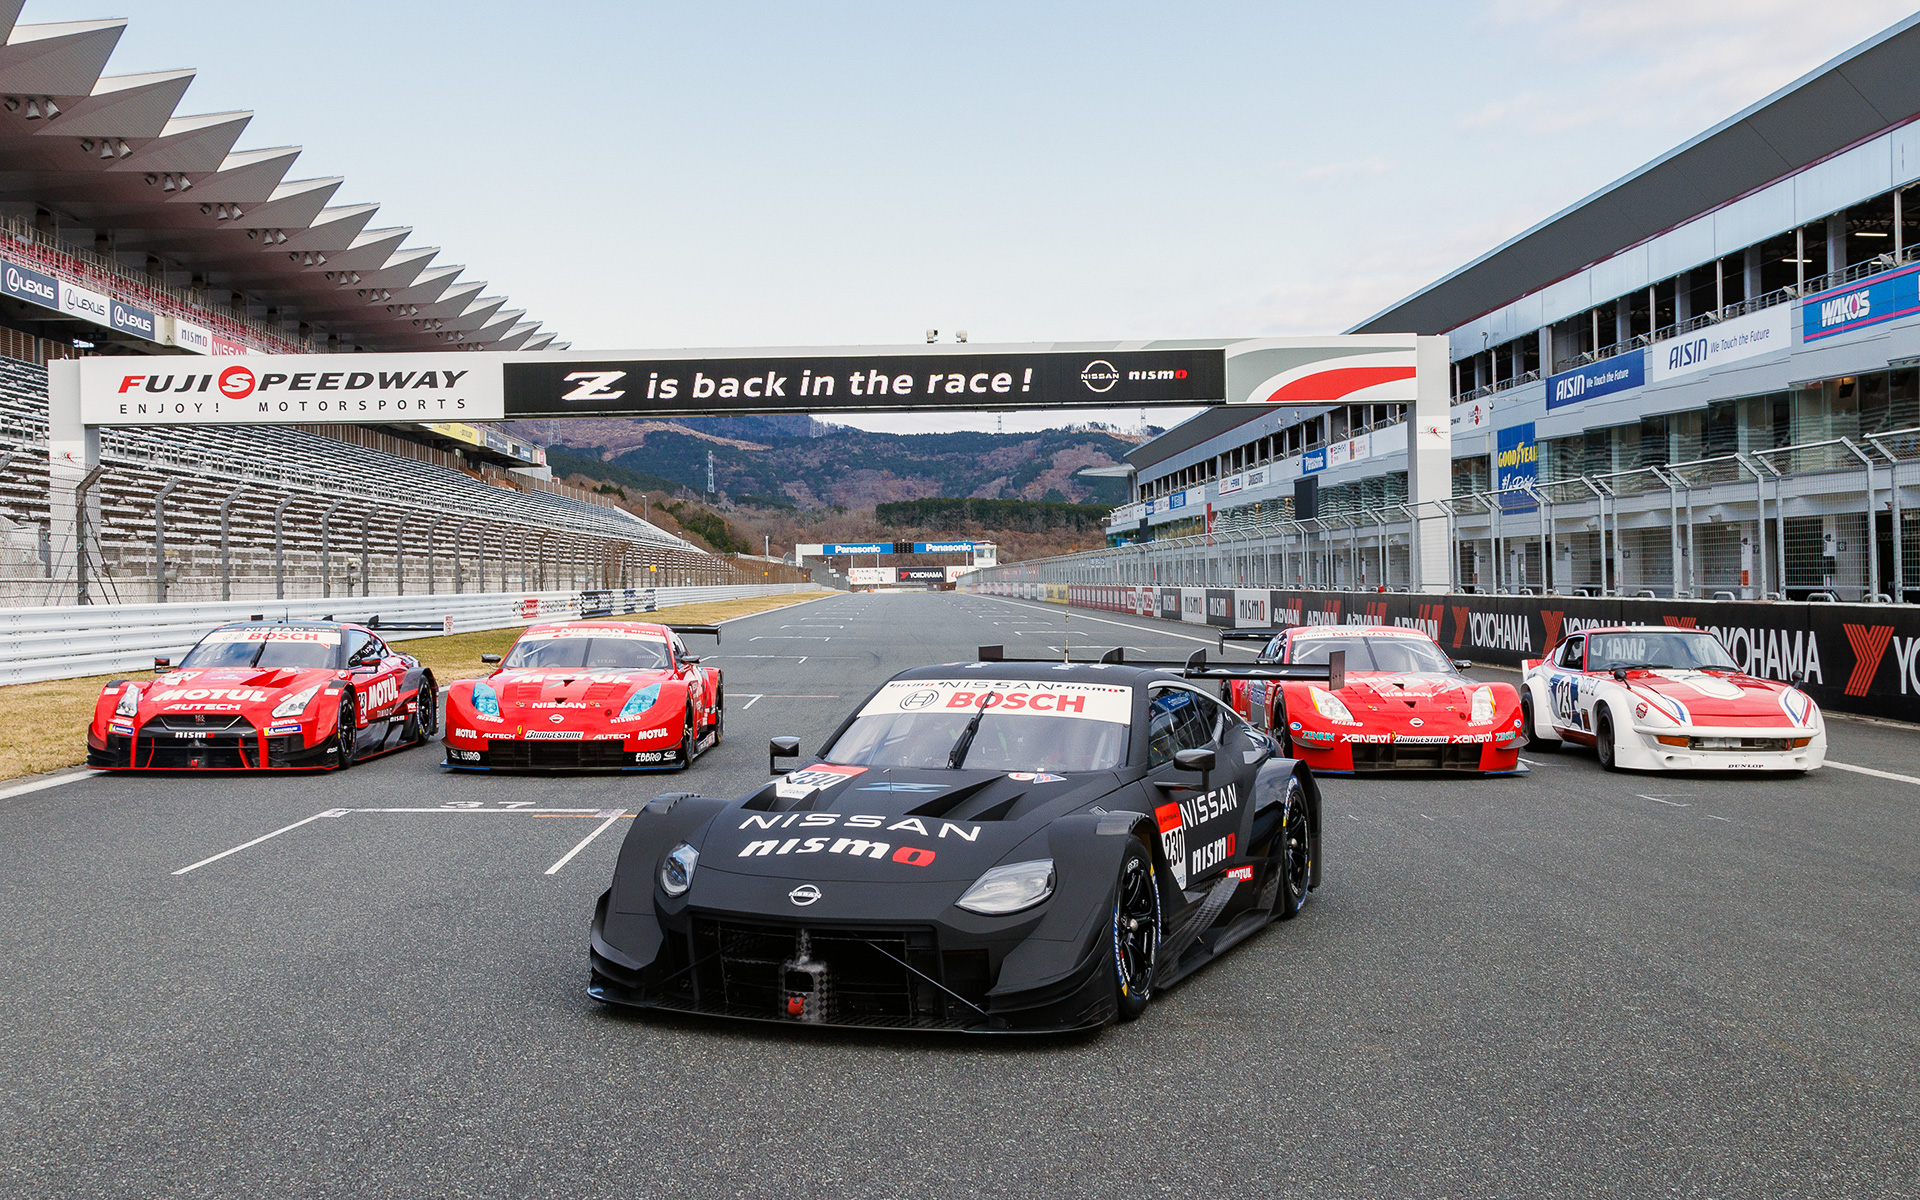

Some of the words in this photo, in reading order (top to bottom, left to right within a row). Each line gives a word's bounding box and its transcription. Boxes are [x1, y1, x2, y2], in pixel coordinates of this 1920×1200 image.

[19, 277, 54, 300] LEXUS
[75, 296, 106, 316] LEXUS
[123, 312, 152, 331] LEXUS
[212, 340, 248, 356] NISS
[1669, 338, 1708, 370] AISIN
[1711, 342, 1720, 353] We
[1721, 337, 1738, 352] Touch
[1738, 335, 1749, 347] the
[1750, 327, 1770, 343] Future
[118, 375, 213, 393] FUJI
[219, 368, 469, 398] SPEEDWAY
[647, 372, 678, 399] is
[692, 370, 787, 399] back
[801, 369, 835, 397] in
[849, 369, 914, 396] the
[1080, 372, 1121, 381] NISSAN
[1127, 370, 1188, 382] nismo
[1556, 374, 1585, 402] AISIN
[1586, 378, 1594, 388] We
[1594, 374, 1606, 387] Touch
[1606, 371, 1614, 383] the
[1614, 368, 1629, 382] Future
[120, 402, 220, 414] ENJOY!
[258, 398, 467, 412] MOTORSPORTS
[1498, 442, 1538, 469] GOODYEAR
[835, 544, 881, 553] Panasonic
[926, 542, 972, 552] Panasonic
[1209, 597, 1231, 618] nismo
[1240, 600, 1265, 621] nismo
[1274, 607, 1300, 626] ADVAN
[1306, 610, 1338, 626] ADVAN
[248, 633, 318, 641] BOSCH
[1468, 612, 1532, 653] YOKOHAMA
[510, 673, 633, 684] MOTUL
[944, 681, 1054, 691] NISSAN
[151, 688, 268, 702] MOTUL
[367, 676, 398, 710] MOTUL
[1557, 680, 1571, 720] 23
[163, 703, 241, 711] AUTECH
[945, 692, 1086, 713] BOSCH
[476, 714, 505, 724] nismo
[610, 715, 642, 724] nismo
[174, 731, 215, 739] nismo
[455, 728, 478, 739] MOTUL
[526, 730, 583, 739] BRIDGESTONE
[638, 728, 668, 740] MOTUL
[1302, 730, 1335, 741] ZENRIN
[1395, 735, 1449, 743] BRIDGESTONE
[1495, 731, 1516, 742] ZENRIN
[635, 752, 662, 763] EBBRO
[790, 771, 847, 787] 230
[1179, 783, 1238, 831] NISSAN
[739, 813, 982, 842] NISSAN
[738, 837, 936, 868] nismo
[1165, 828, 1184, 867] 230
[1192, 832, 1236, 876] nismo
[1228, 867, 1252, 880] MOTUL
[788, 890, 822, 899] NISSAN
